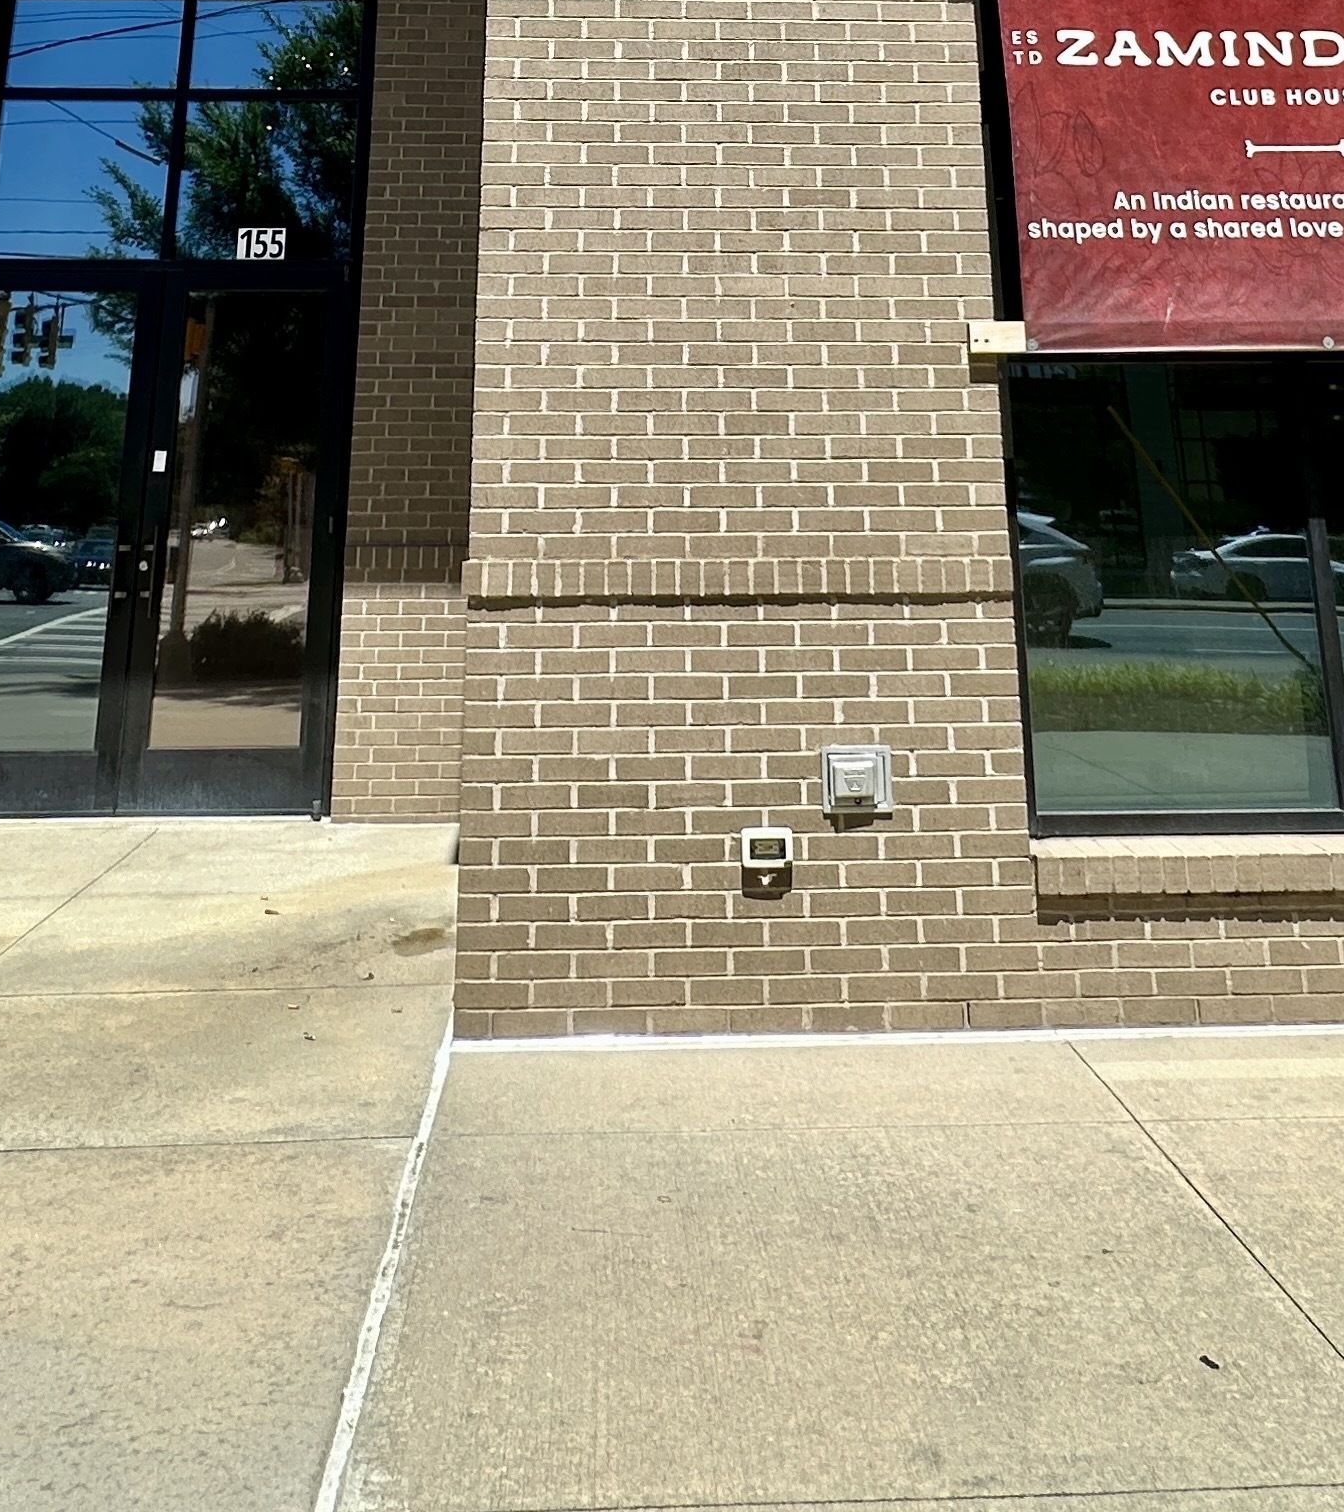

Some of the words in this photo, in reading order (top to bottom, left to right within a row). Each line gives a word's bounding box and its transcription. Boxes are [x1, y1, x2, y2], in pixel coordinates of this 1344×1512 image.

[1011, 30, 1038, 45] ES
[1012, 50, 1043, 65] TD
[1210, 88, 1276, 106] CLUB
[1113, 191, 1146, 211] An
[1152, 189, 1234, 211] Indian
[1027, 217, 1124, 244] shaped
[1130, 218, 1163, 244] by
[1169, 222, 1187, 239] a
[1193, 217, 1284, 239] shared
[1289, 217, 1344, 238] love
[240, 229, 284, 258] 155
